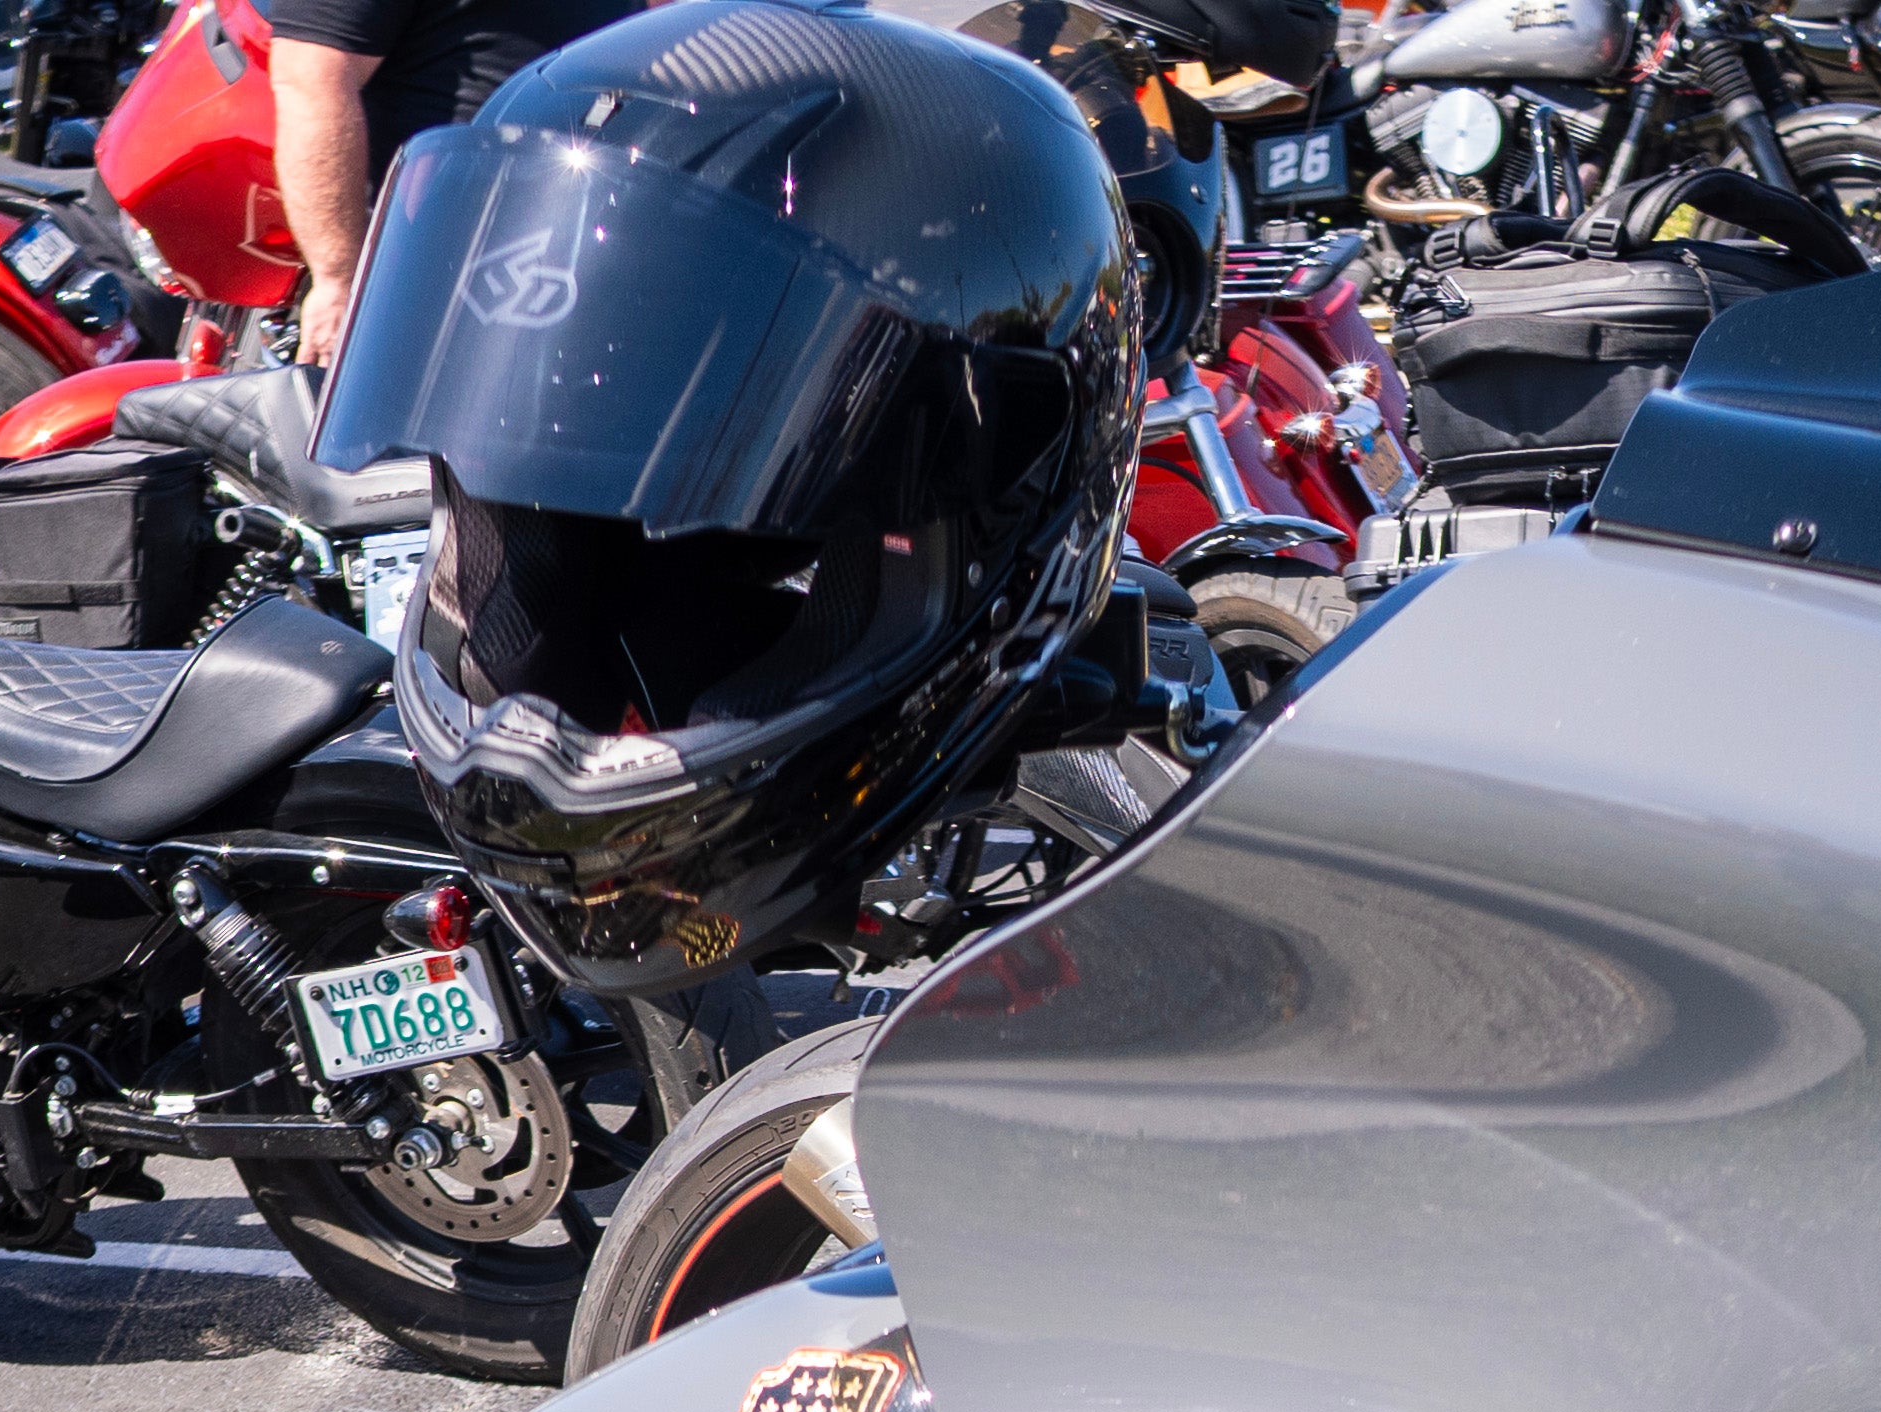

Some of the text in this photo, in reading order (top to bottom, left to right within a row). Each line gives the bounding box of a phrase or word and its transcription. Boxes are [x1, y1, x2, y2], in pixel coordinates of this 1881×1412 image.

[1268, 133, 1330, 188] 26
[327, 977, 373, 1002] N.H.
[400, 964, 427, 984] 12
[330, 986, 475, 1057] 7D688
[360, 1034, 466, 1067] MOTORCYCLE
[775, 1103, 832, 1136] 20
